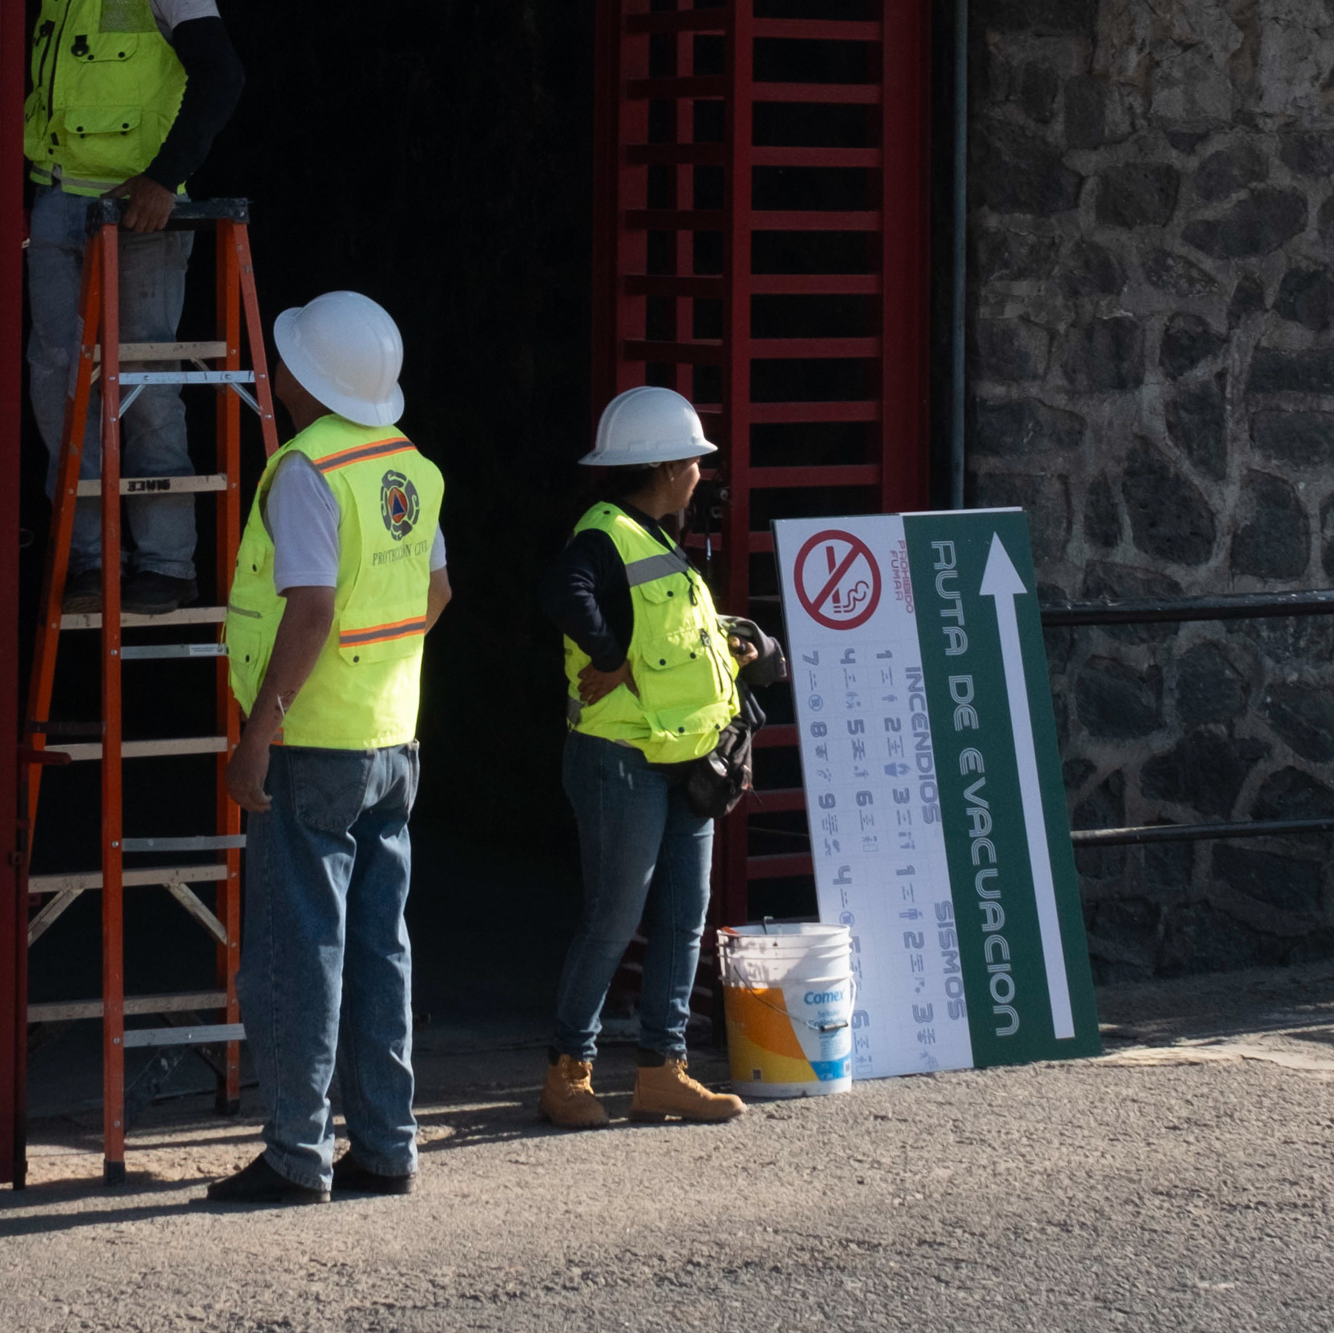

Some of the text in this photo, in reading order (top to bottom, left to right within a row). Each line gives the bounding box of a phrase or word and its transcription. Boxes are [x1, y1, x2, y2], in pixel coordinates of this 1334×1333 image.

[890, 550, 903, 601] FUMAR
[897, 539, 914, 614] PROHIBIDO
[802, 650, 820, 666] 7
[840, 648, 856, 665] 4
[876, 650, 893, 659] 1
[810, 721, 828, 738] 8
[847, 719, 865, 735] 5
[884, 717, 902, 733] 2
[905, 667, 942, 825] INCENDIOS
[892, 787, 910, 804] 3
[931, 540, 1020, 1037] RUTA DE EVACUACION
[818, 793, 836, 809] 9
[855, 790, 874, 807] 6
[832, 865, 852, 885] 4
[896, 865, 915, 876] 1
[903, 931, 925, 950] 2
[934, 900, 967, 1021] SISMOS
[804, 991, 844, 1005] Comex
[912, 1003, 934, 1024] 3
